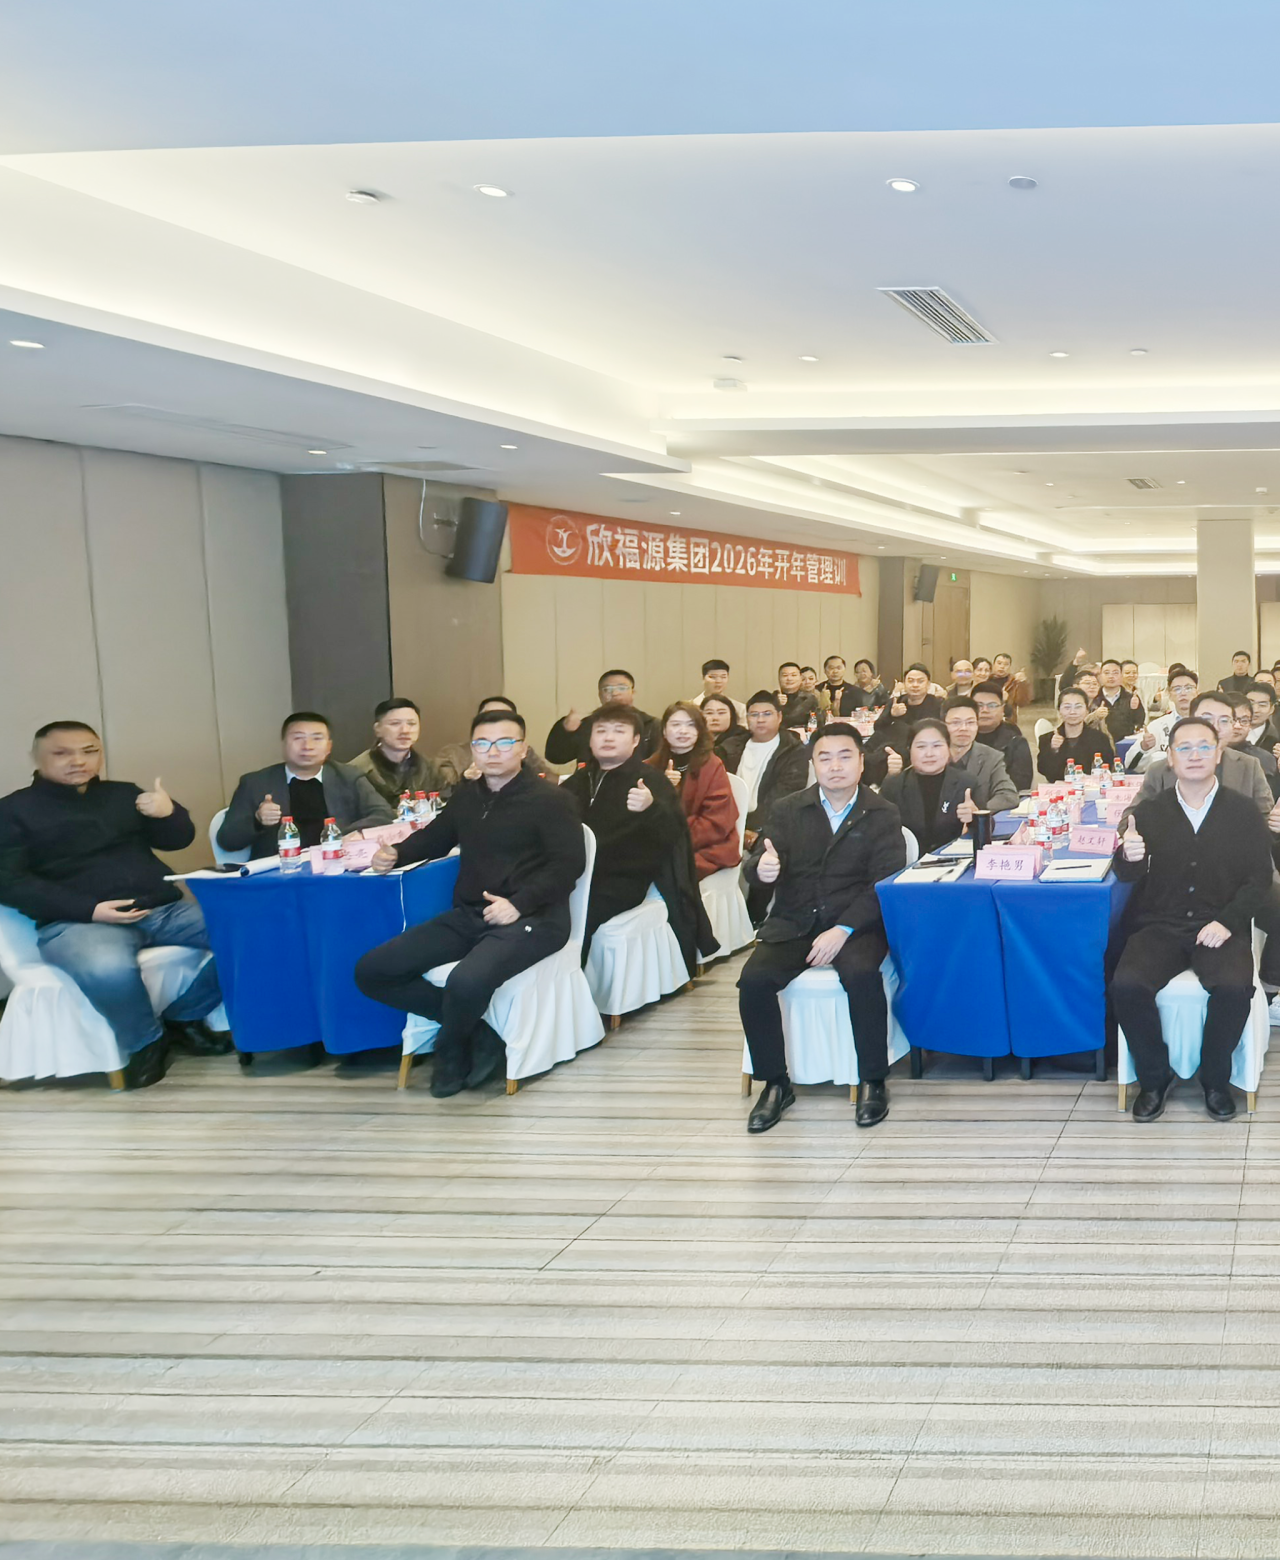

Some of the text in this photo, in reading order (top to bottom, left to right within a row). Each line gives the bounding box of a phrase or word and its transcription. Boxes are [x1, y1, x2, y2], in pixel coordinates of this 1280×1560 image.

[586, 523, 847, 586] 欣福源集团2026年开年管理训
